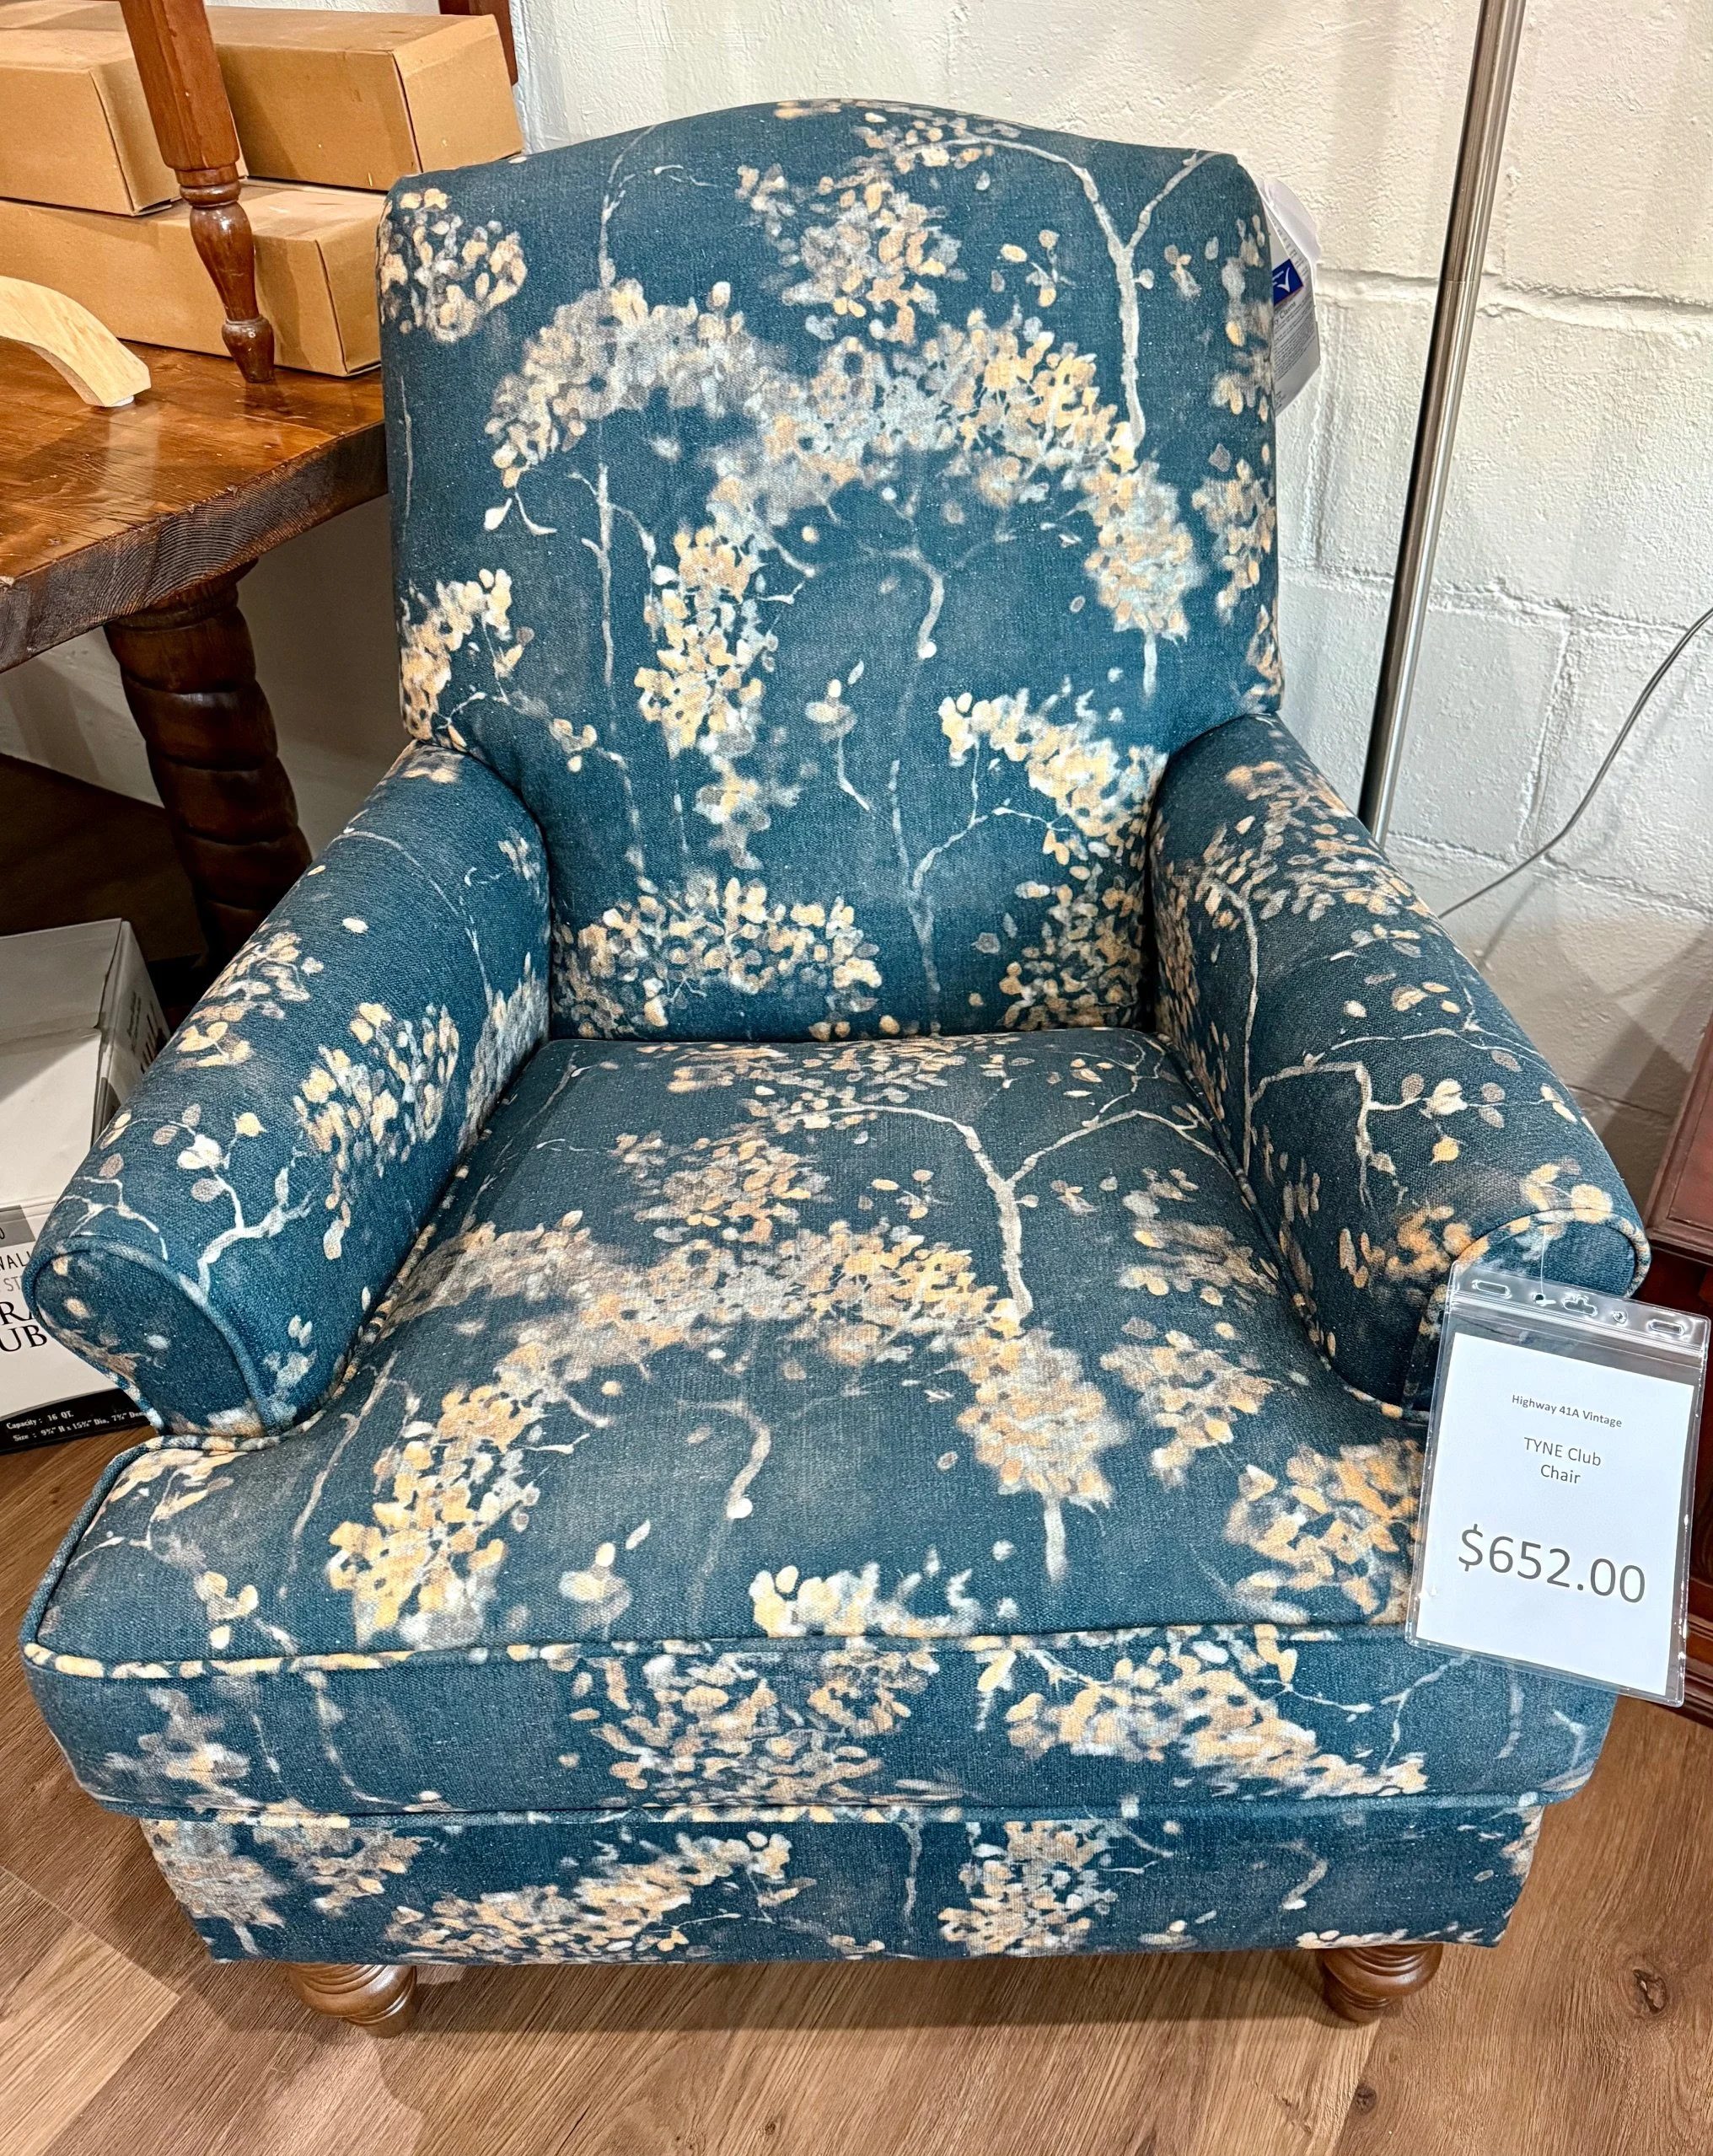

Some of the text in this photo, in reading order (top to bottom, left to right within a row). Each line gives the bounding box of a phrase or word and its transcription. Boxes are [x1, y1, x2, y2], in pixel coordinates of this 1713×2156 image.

[6, 1418, 37, 1430] Capacity
[47, 1413, 58, 1422] 16
[1512, 1394, 1623, 1428] Highway 41A Vintage
[1523, 1436, 1602, 1467] TYNE Club
[1540, 1464, 1581, 1483] Chair
[1458, 1523, 1646, 1603] $652.00
